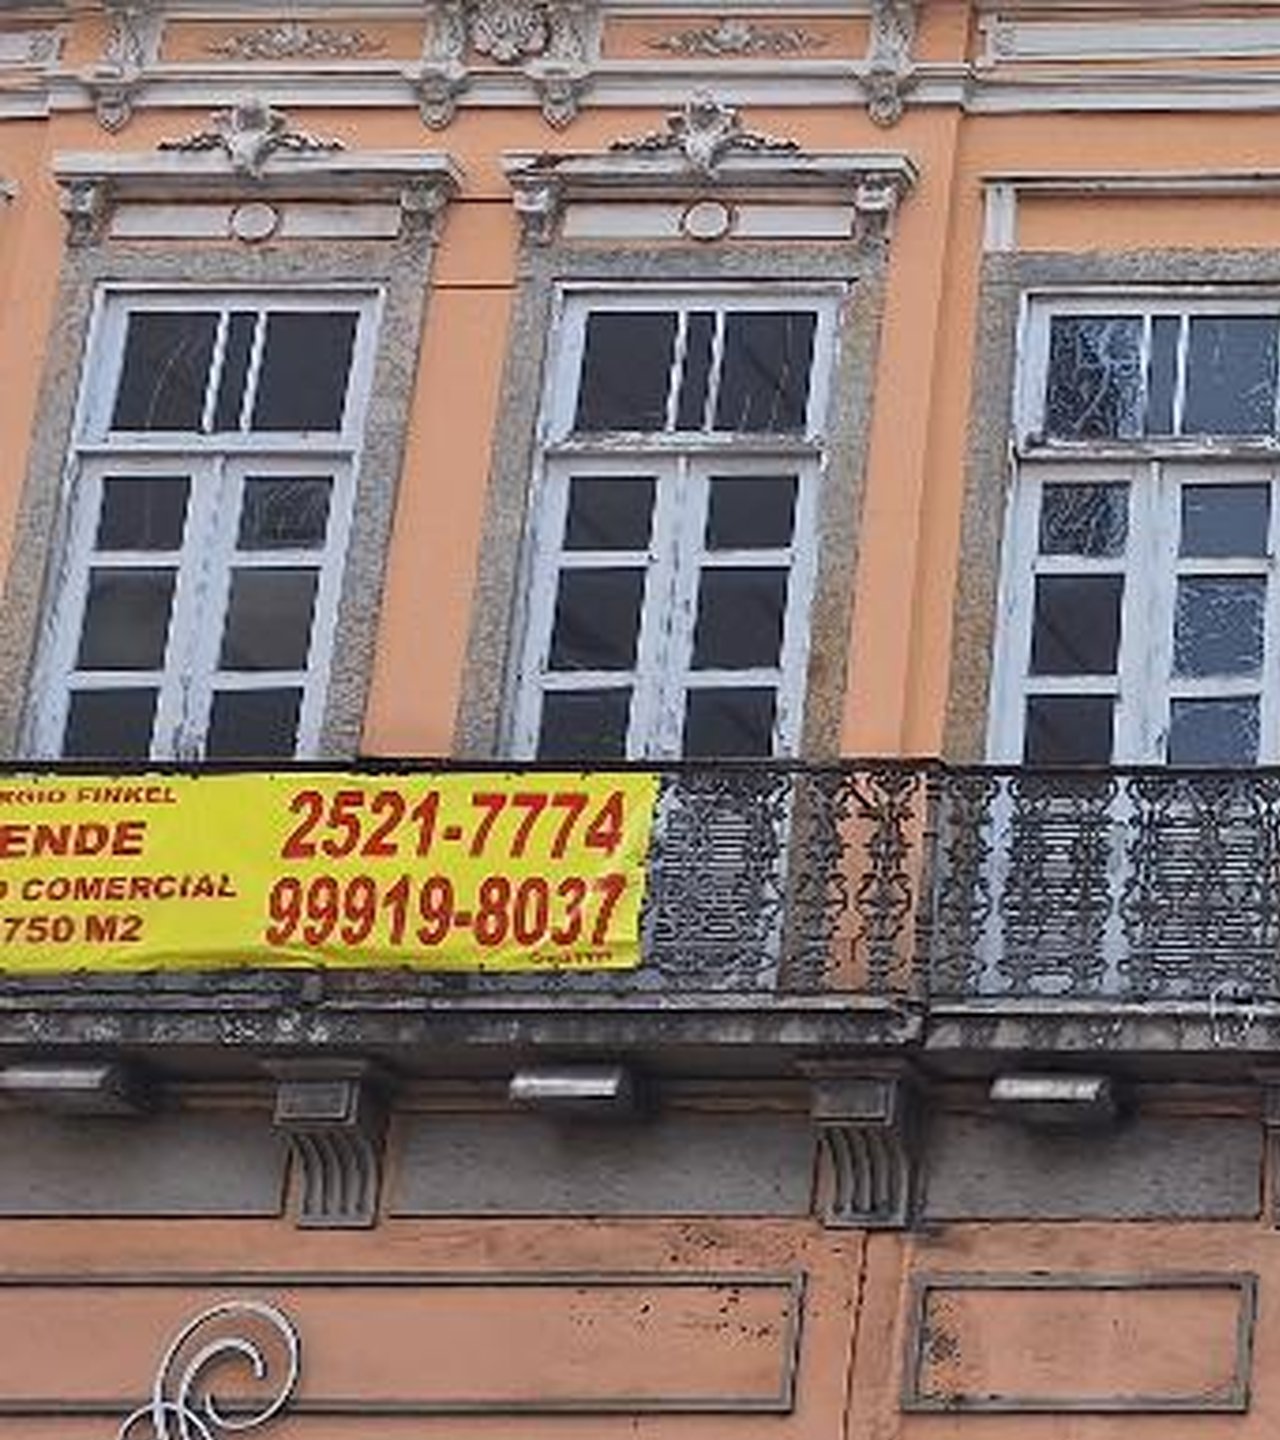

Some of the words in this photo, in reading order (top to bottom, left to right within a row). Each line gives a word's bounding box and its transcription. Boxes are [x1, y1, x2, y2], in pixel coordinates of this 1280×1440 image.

[77, 786, 177, 804] FINKEL
[0, 821, 147, 858] ENDE
[281, 790, 626, 860] 2521-7774
[21, 873, 238, 902] COMERCIAL
[266, 873, 627, 947] 99919-8037
[3, 915, 74, 943] 750
[85, 914, 143, 942] M2
